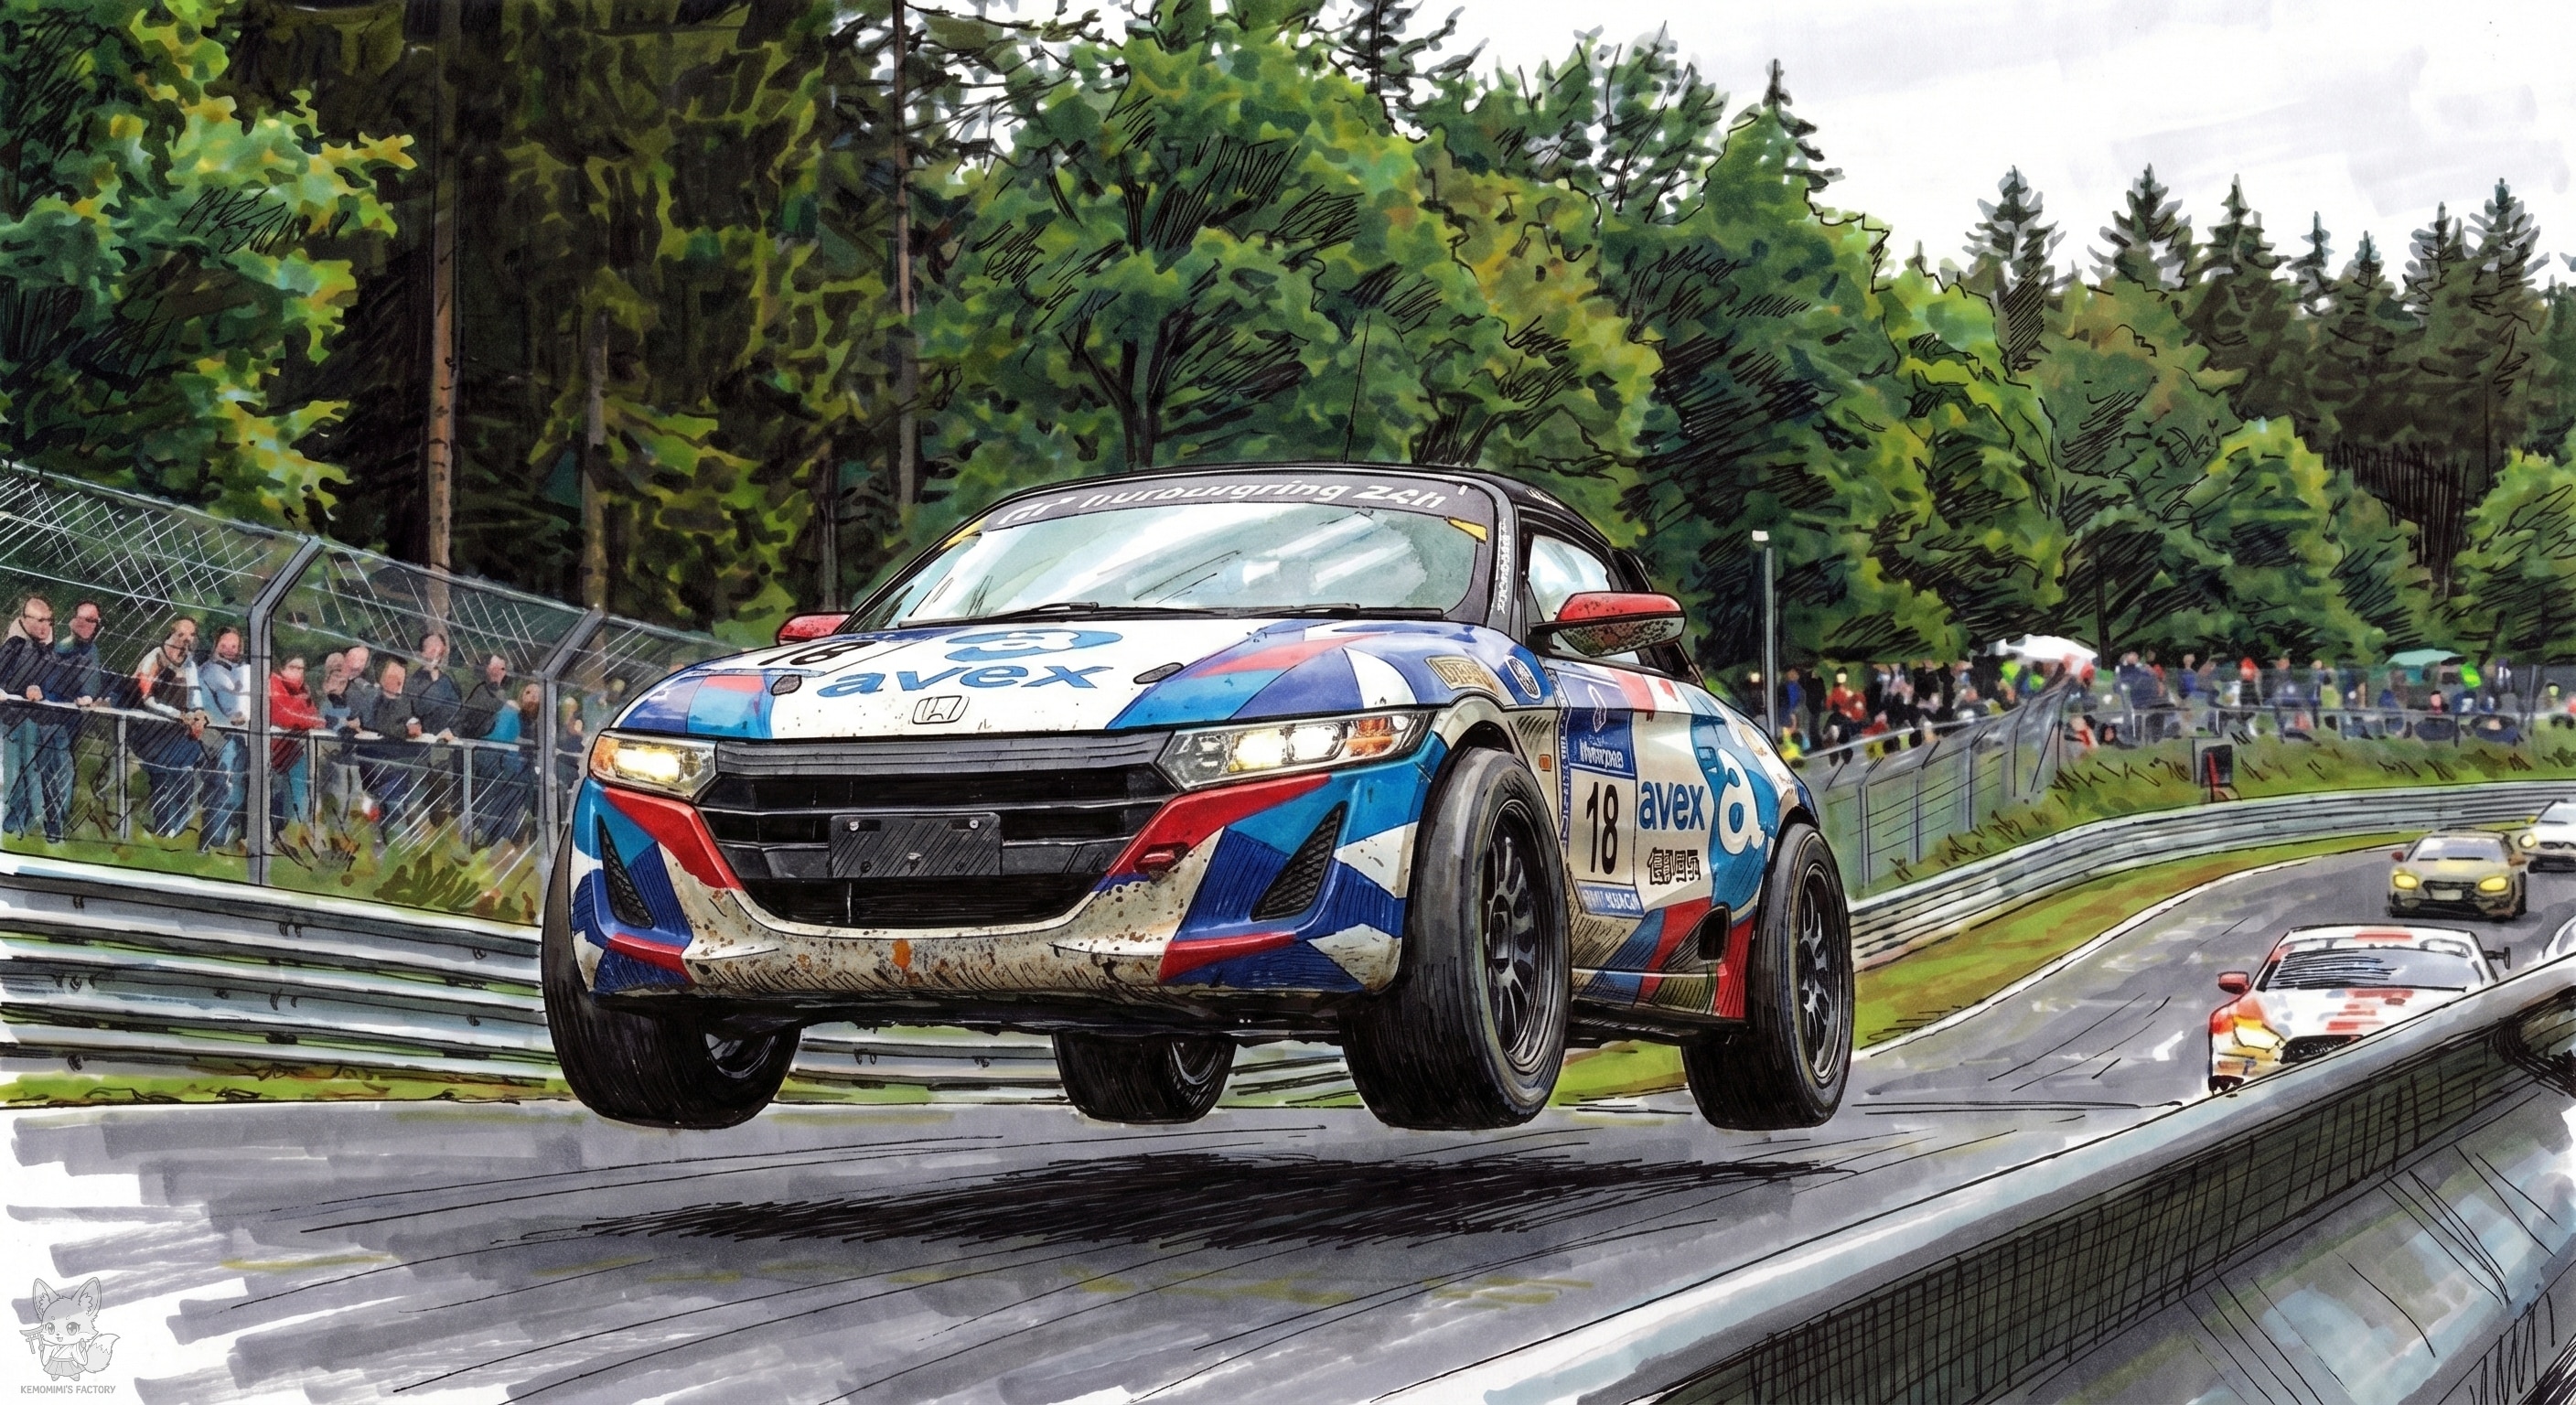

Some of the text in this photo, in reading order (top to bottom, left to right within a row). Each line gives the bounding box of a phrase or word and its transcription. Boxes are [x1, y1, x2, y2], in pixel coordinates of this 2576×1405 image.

[757, 640, 876, 666] 18
[818, 666, 1113, 697] avex
[1638, 780, 1706, 831] avex
[1586, 781, 1619, 874] 18
